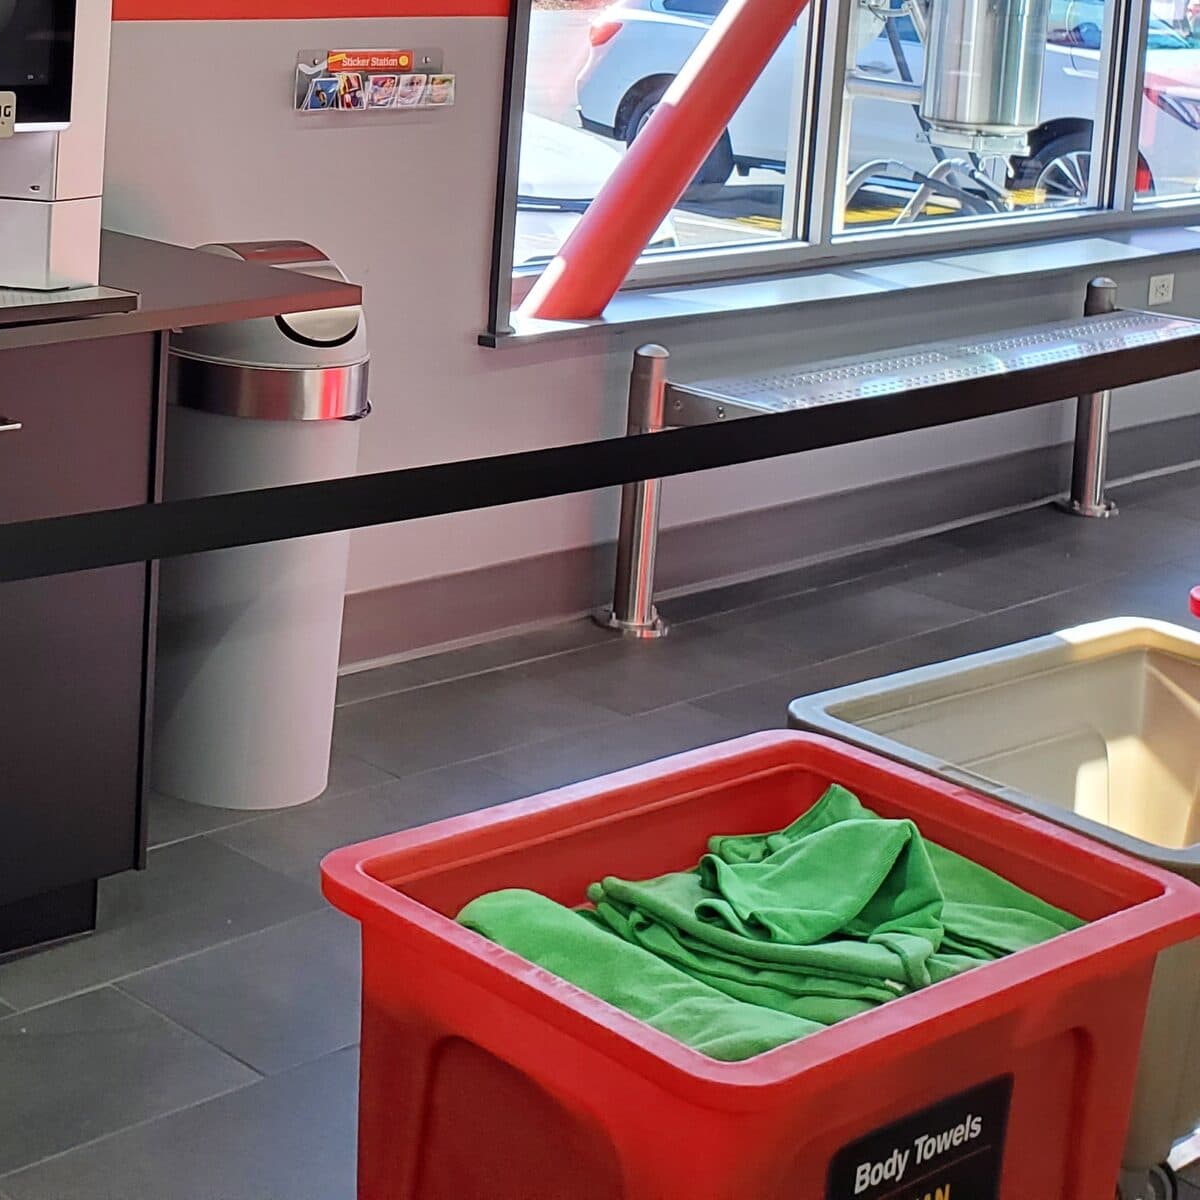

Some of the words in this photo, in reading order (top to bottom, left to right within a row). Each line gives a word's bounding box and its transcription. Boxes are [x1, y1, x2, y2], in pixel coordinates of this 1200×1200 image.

[342, 56, 370, 67] Sticker
[371, 56, 398, 67] Station
[854, 1148, 910, 1195] Body
[914, 1113, 983, 1165] Towels
